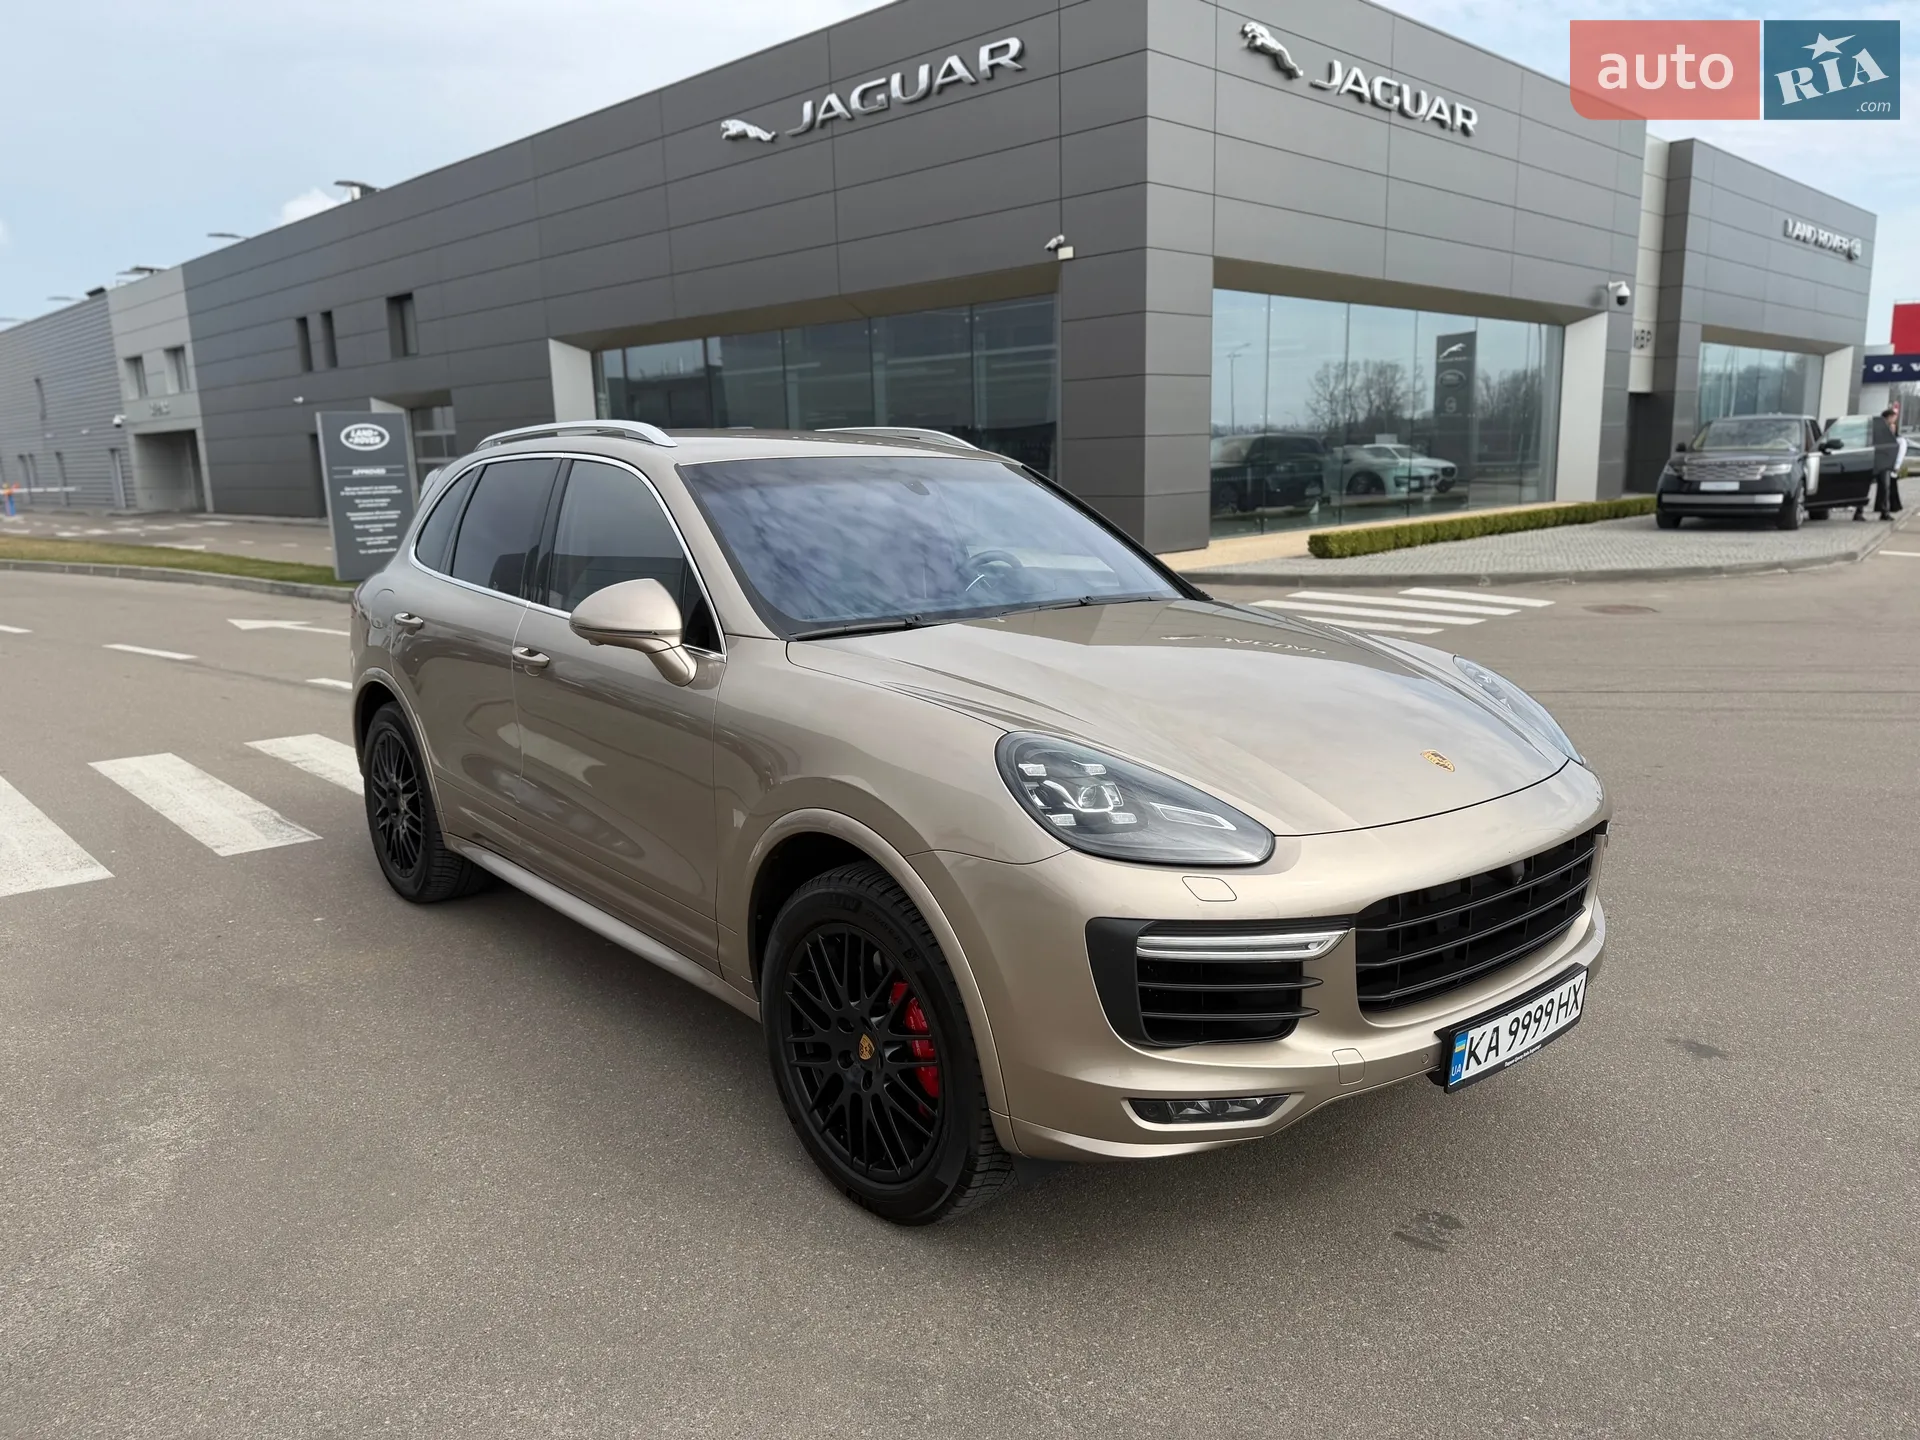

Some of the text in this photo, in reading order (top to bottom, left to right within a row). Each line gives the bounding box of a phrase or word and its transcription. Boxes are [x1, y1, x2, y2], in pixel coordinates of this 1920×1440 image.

[785, 37, 1025, 136] JAGUAR
[1310, 60, 1478, 136] JAGUAR
[1817, 229, 1849, 254] ROVER
[1465, 1025, 1500, 1071] KA
[1507, 998, 1555, 1053] 9999
[1555, 979, 1583, 1024] HX
[1451, 1063, 1462, 1077] UA
